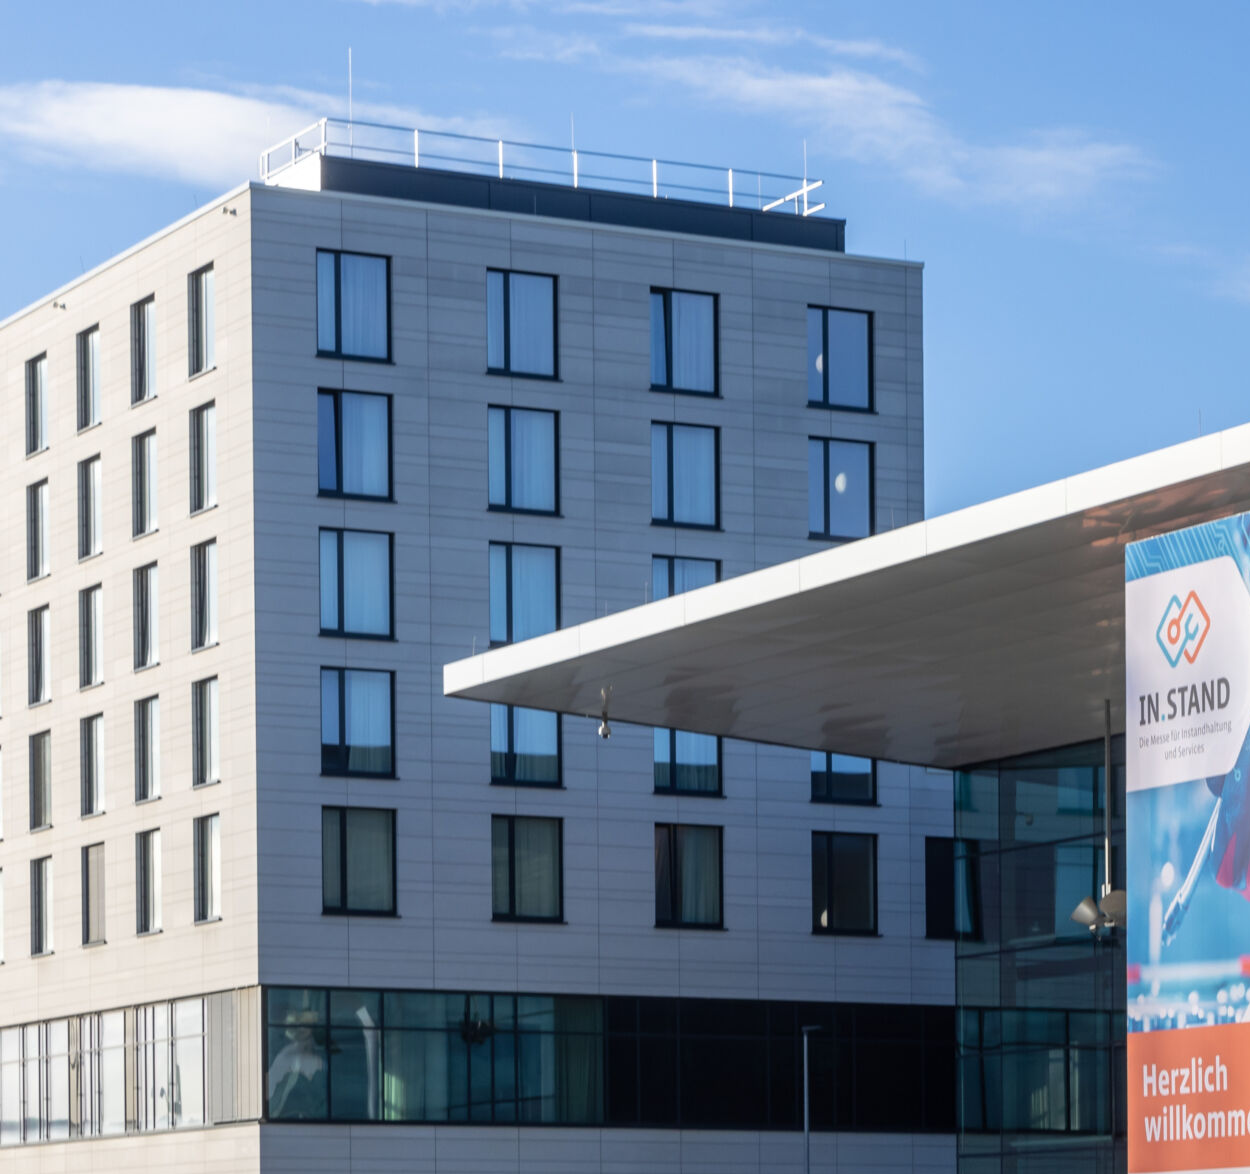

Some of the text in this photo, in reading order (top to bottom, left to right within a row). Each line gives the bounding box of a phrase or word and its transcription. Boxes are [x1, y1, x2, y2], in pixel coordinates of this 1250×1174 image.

[1139, 677, 1230, 727] IN.STAND
[1139, 720, 1232, 749] Die Messe für Instandhaltung
[1164, 743, 1205, 760] und Services
[1142, 1055, 1228, 1097] Herzlich
